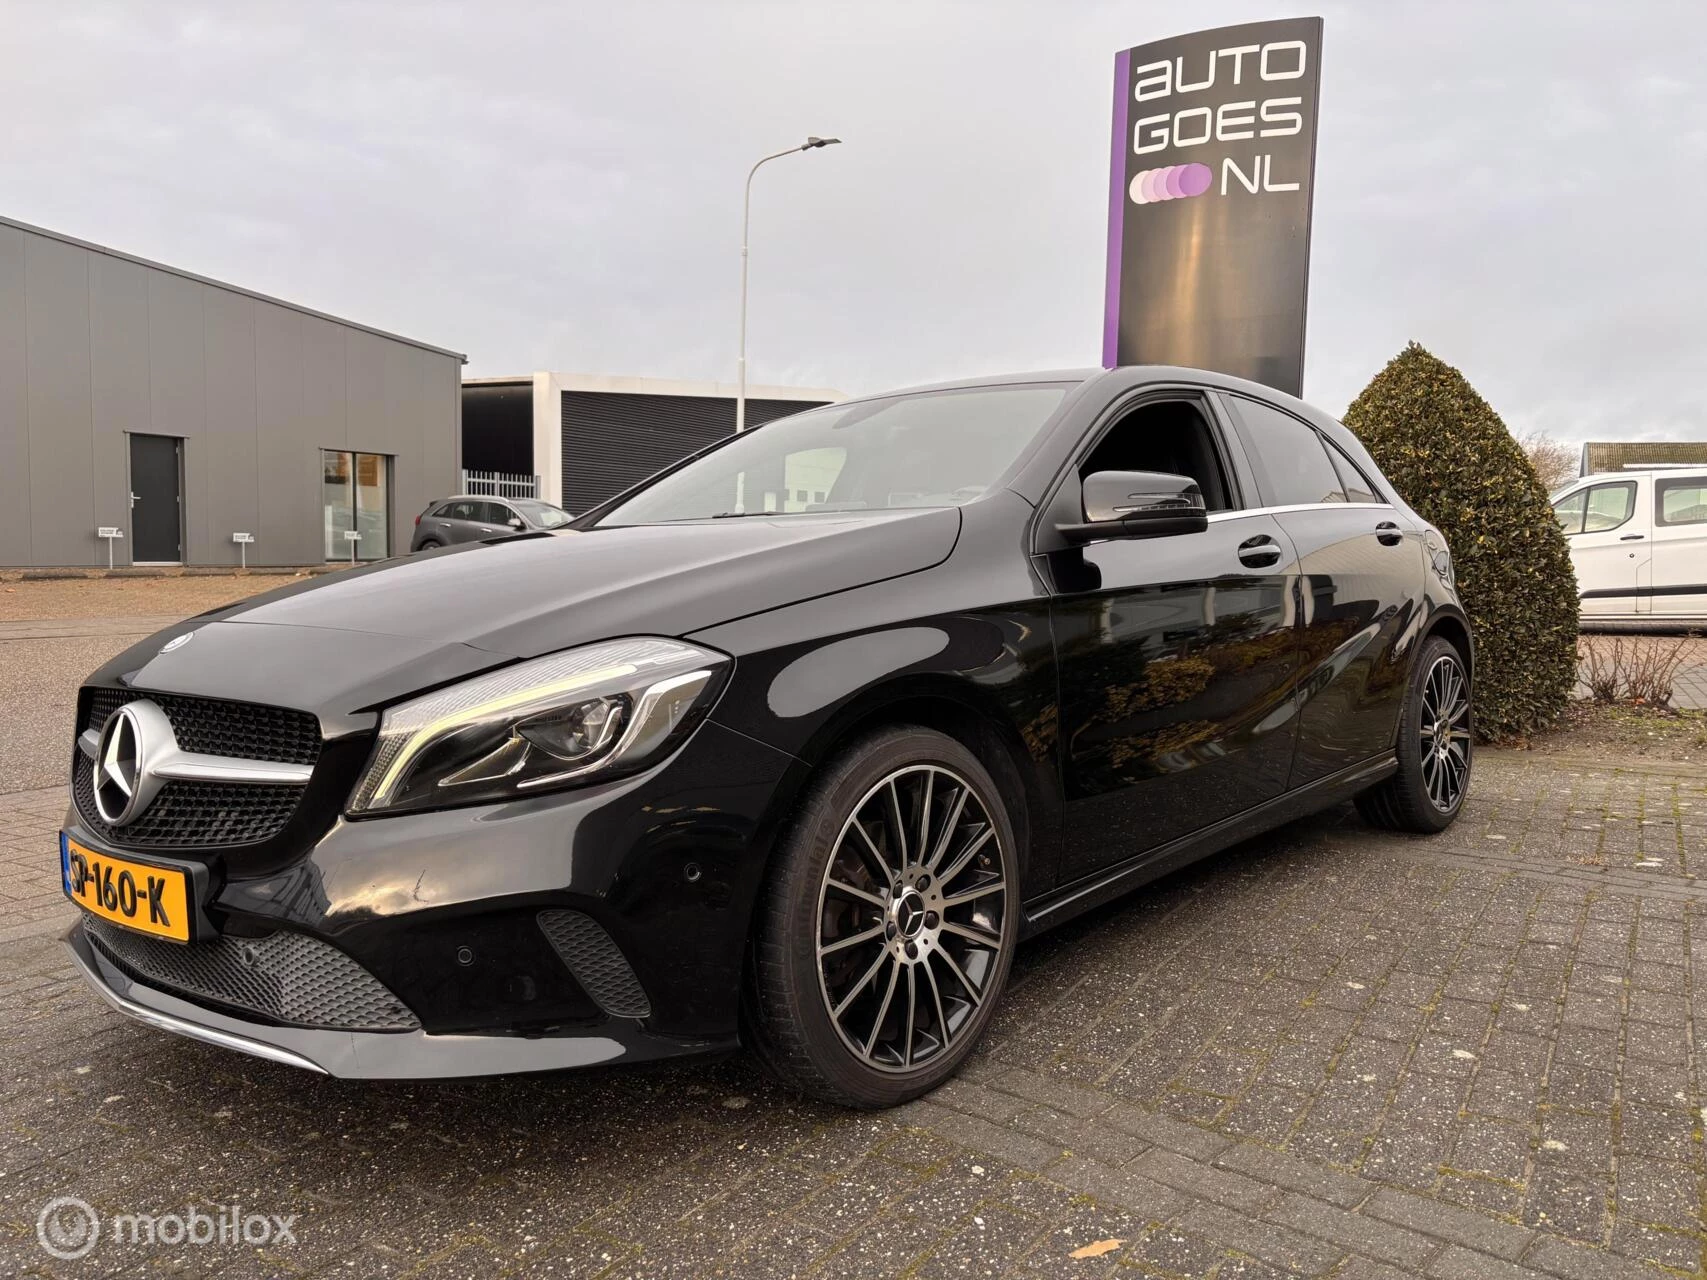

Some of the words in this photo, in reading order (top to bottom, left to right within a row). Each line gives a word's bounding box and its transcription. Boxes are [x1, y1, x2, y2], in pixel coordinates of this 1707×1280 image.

[1133, 96, 1303, 155] GOES
[1220, 154, 1300, 196] NL
[70, 848, 171, 927] SP-160-K
